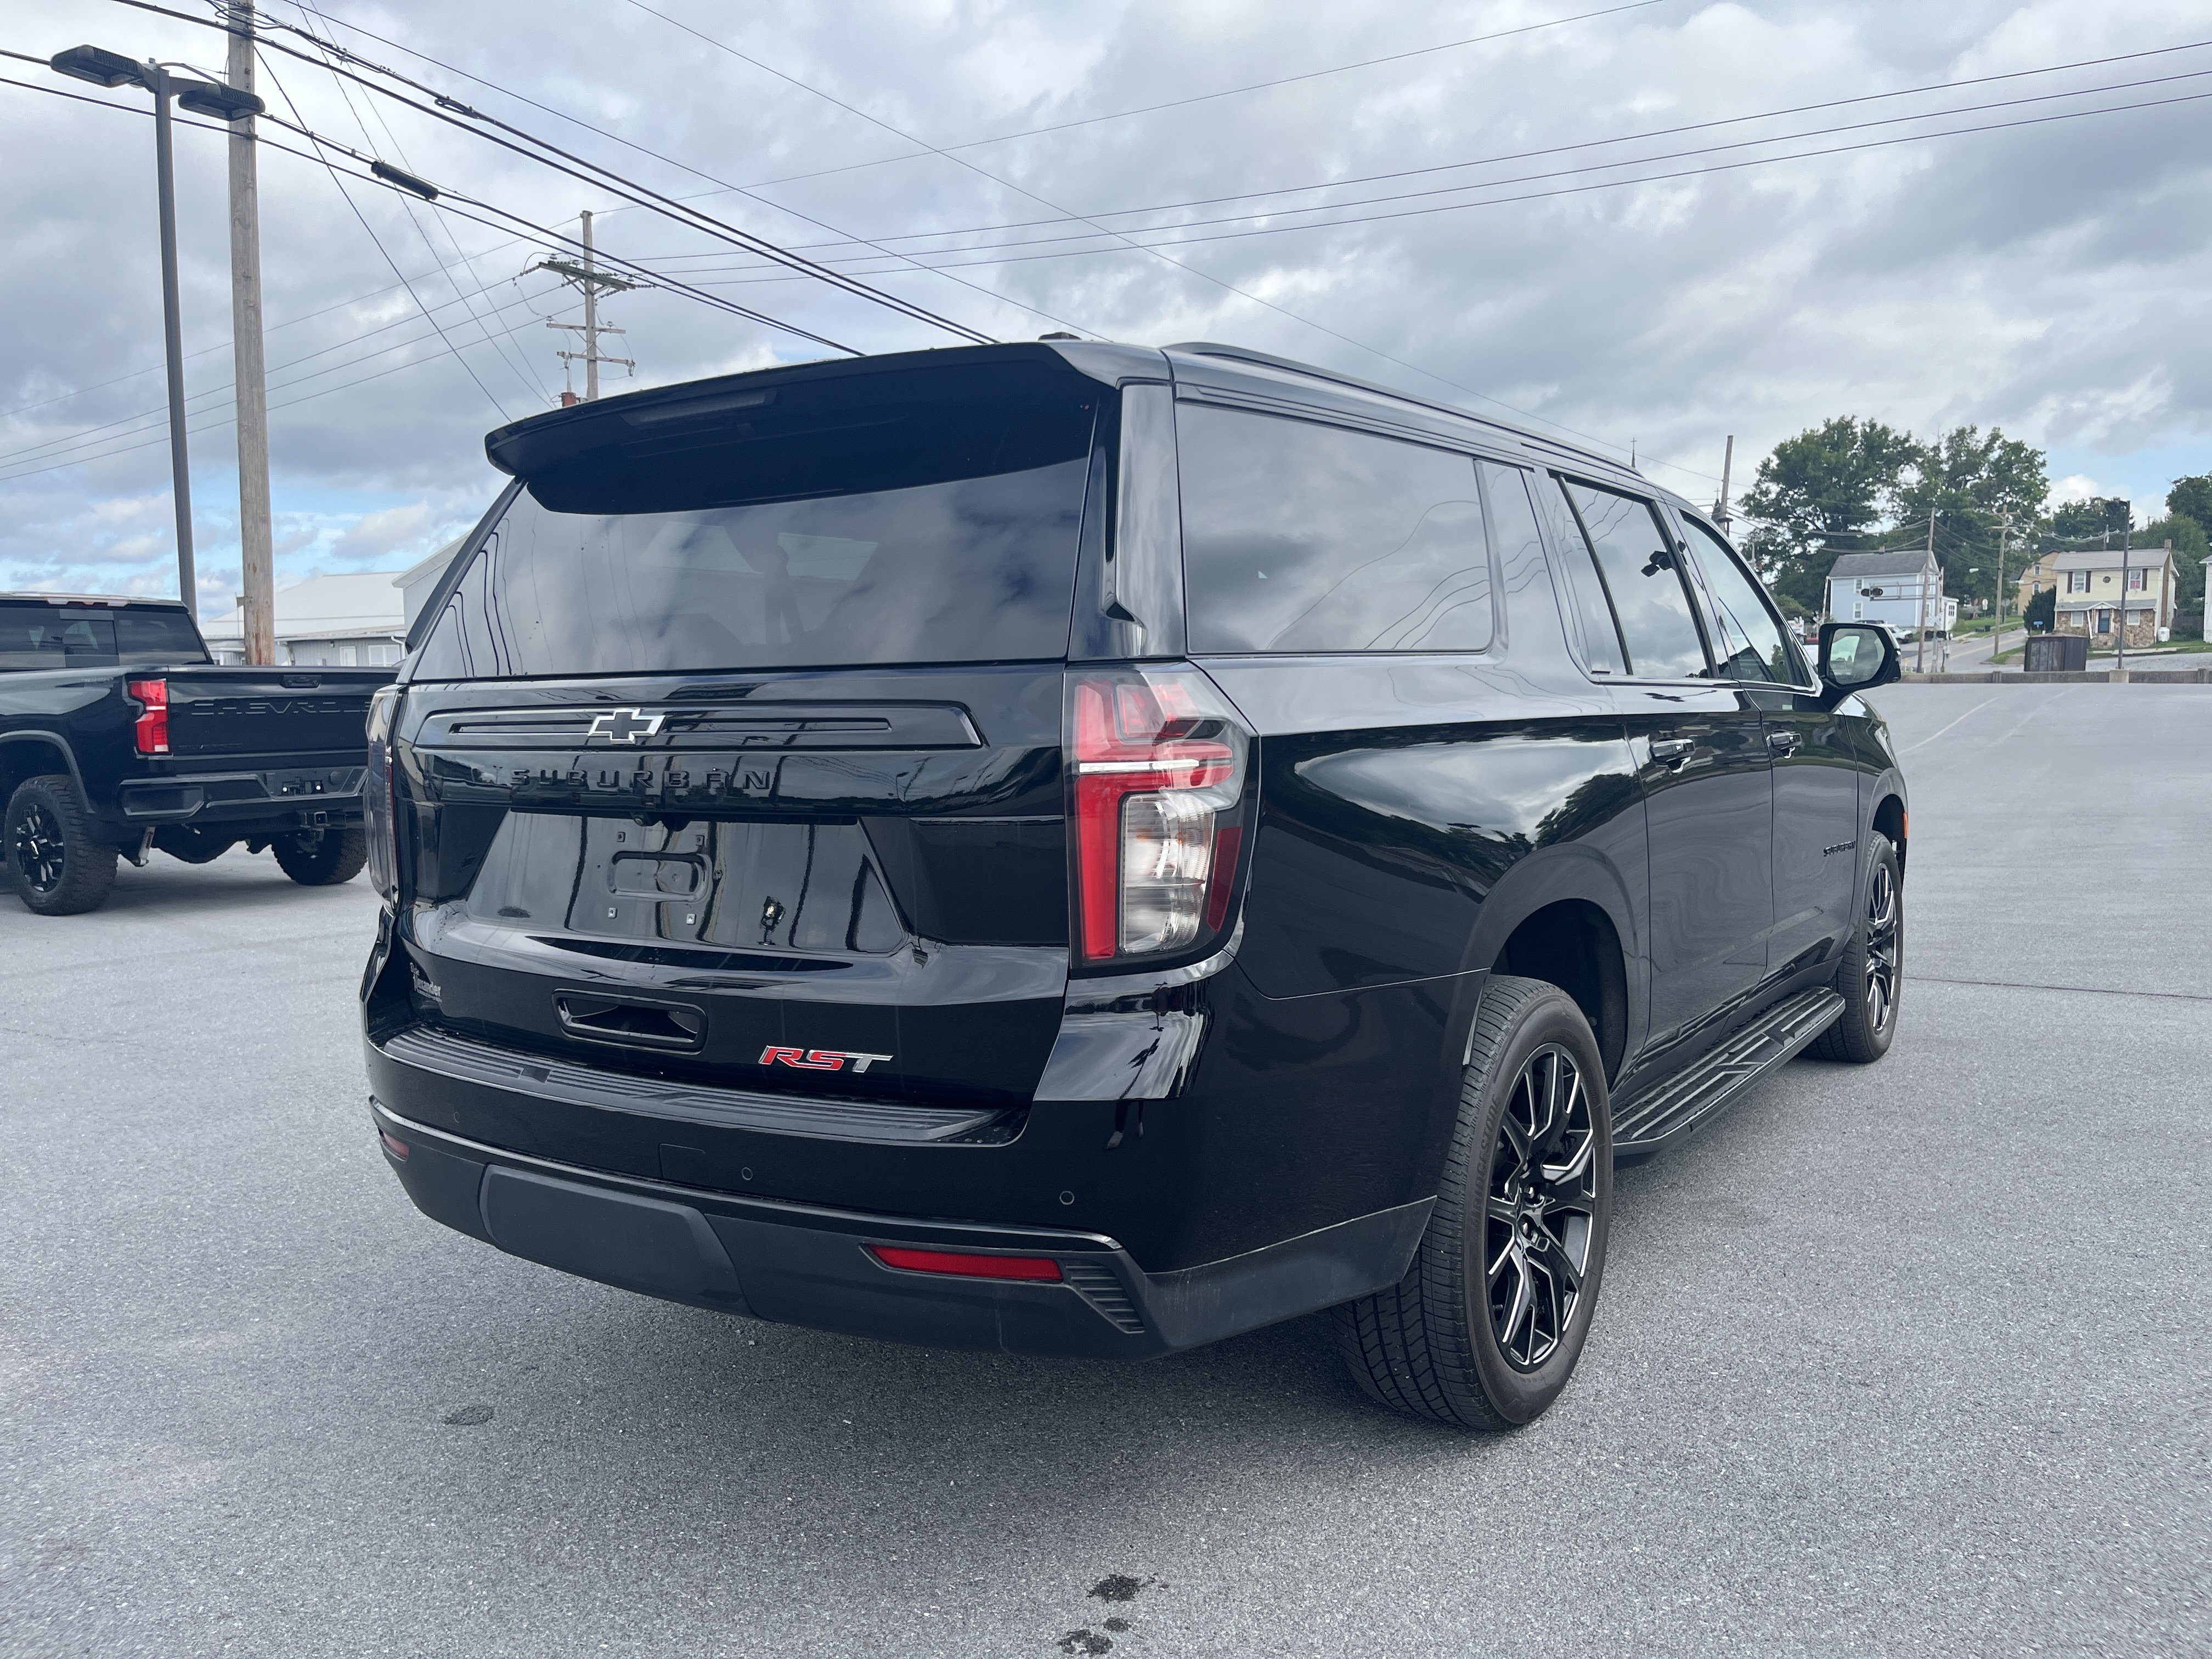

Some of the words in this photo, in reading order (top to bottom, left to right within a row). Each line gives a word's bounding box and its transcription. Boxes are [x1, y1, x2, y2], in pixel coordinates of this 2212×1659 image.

[510, 769, 770, 789] SUBURBAN
[1823, 840, 1855, 857] SUBURBAN
[758, 1045, 894, 1073] RST
